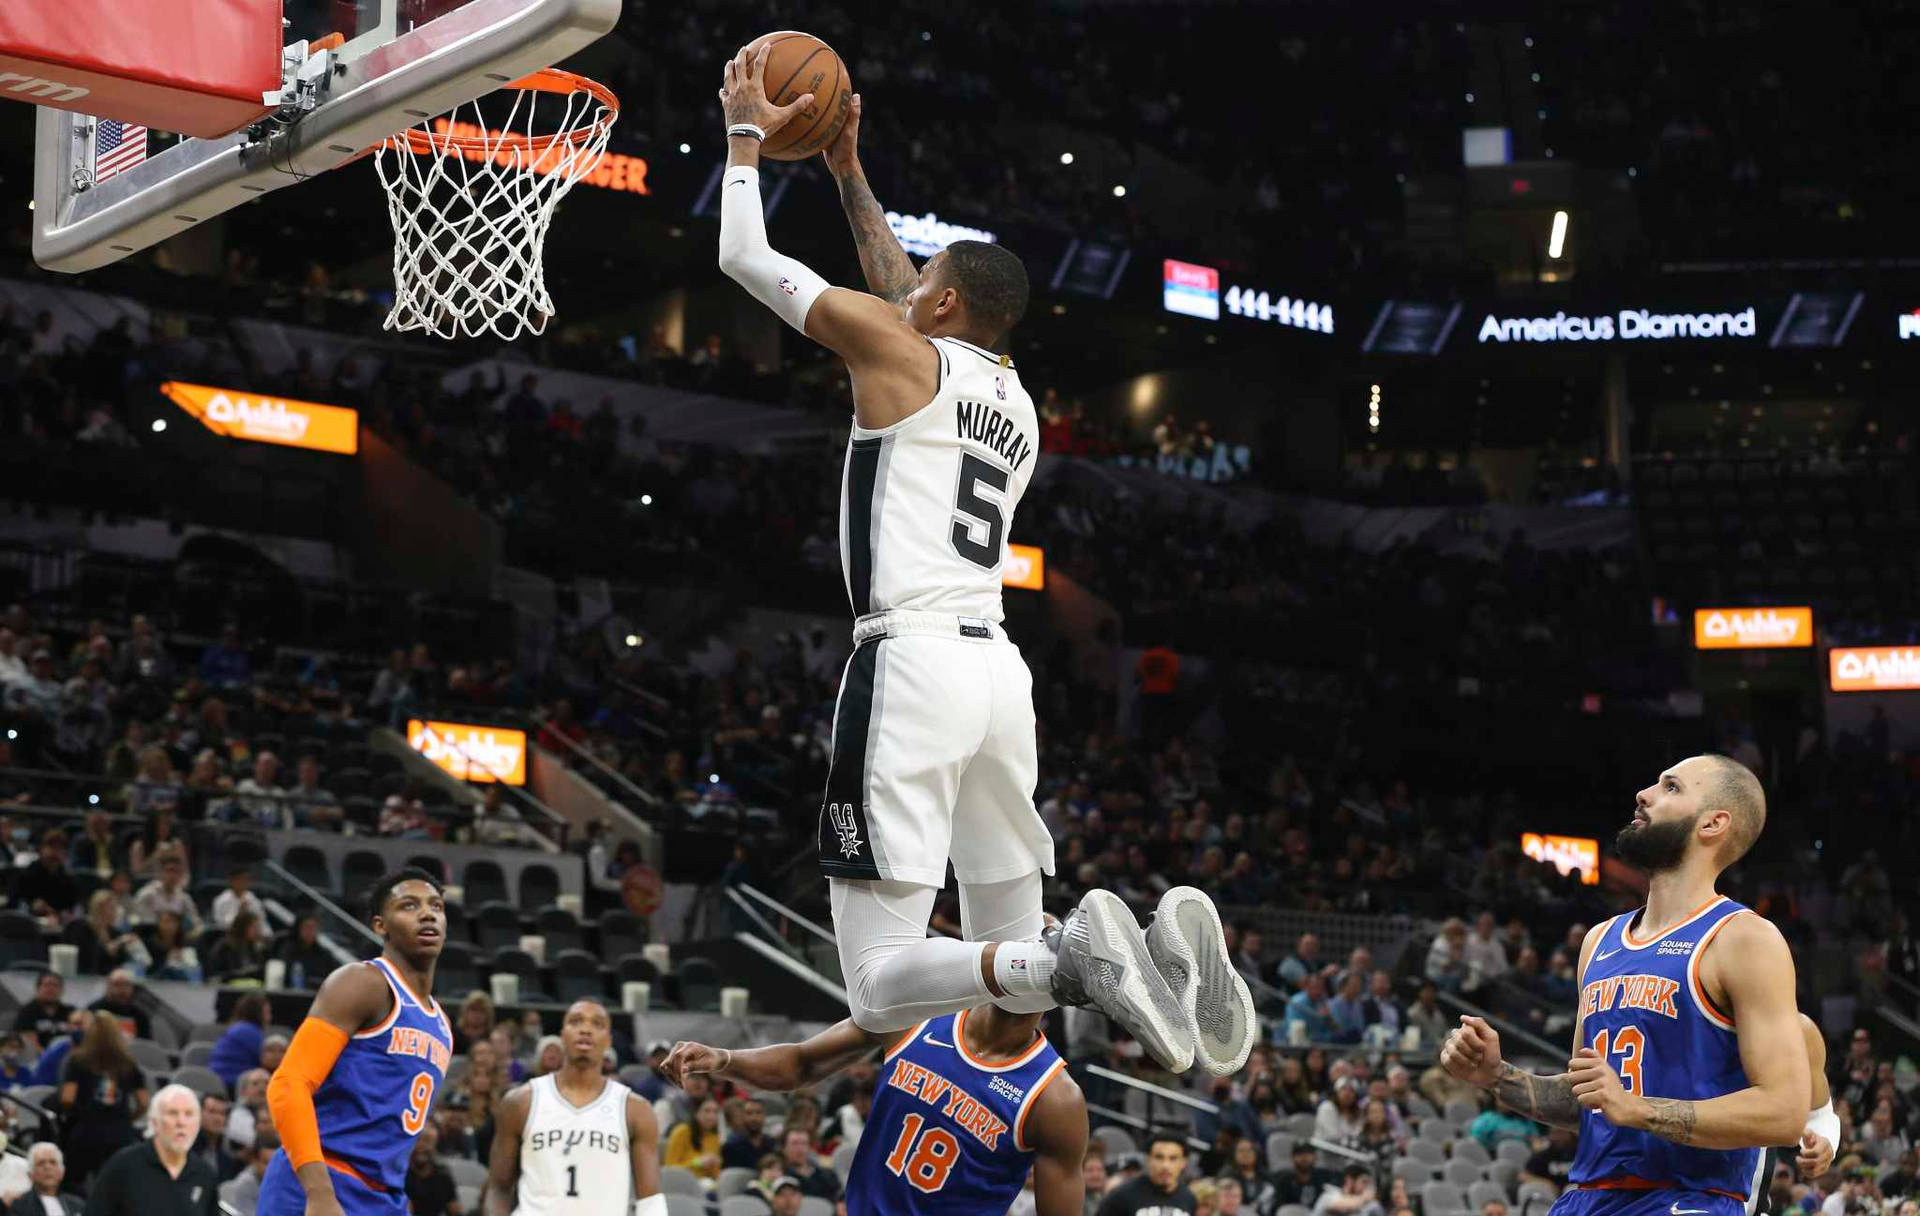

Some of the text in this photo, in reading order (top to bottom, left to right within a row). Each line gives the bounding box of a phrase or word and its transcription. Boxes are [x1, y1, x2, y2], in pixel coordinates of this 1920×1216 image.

[1224, 285, 1334, 334] 444-4444
[1478, 306, 1756, 342] Americus Diamond
[957, 401, 1031, 471] MURRAY
[949, 446, 1012, 573] 5
[1656, 947, 1684, 955] SPACE
[1659, 940, 1695, 949] SQUARE
[1619, 974, 1681, 1020] YORK
[387, 1027, 431, 1059] NEW
[401, 1071, 435, 1136] 9
[988, 1081, 1015, 1101] SPACE
[991, 1075, 1025, 1098] SQUARE
[888, 1058, 1009, 1152] NEW YORK
[532, 1129, 621, 1156] SPURS
[885, 1112, 961, 1194] 18
[566, 1165, 579, 1197] 1
